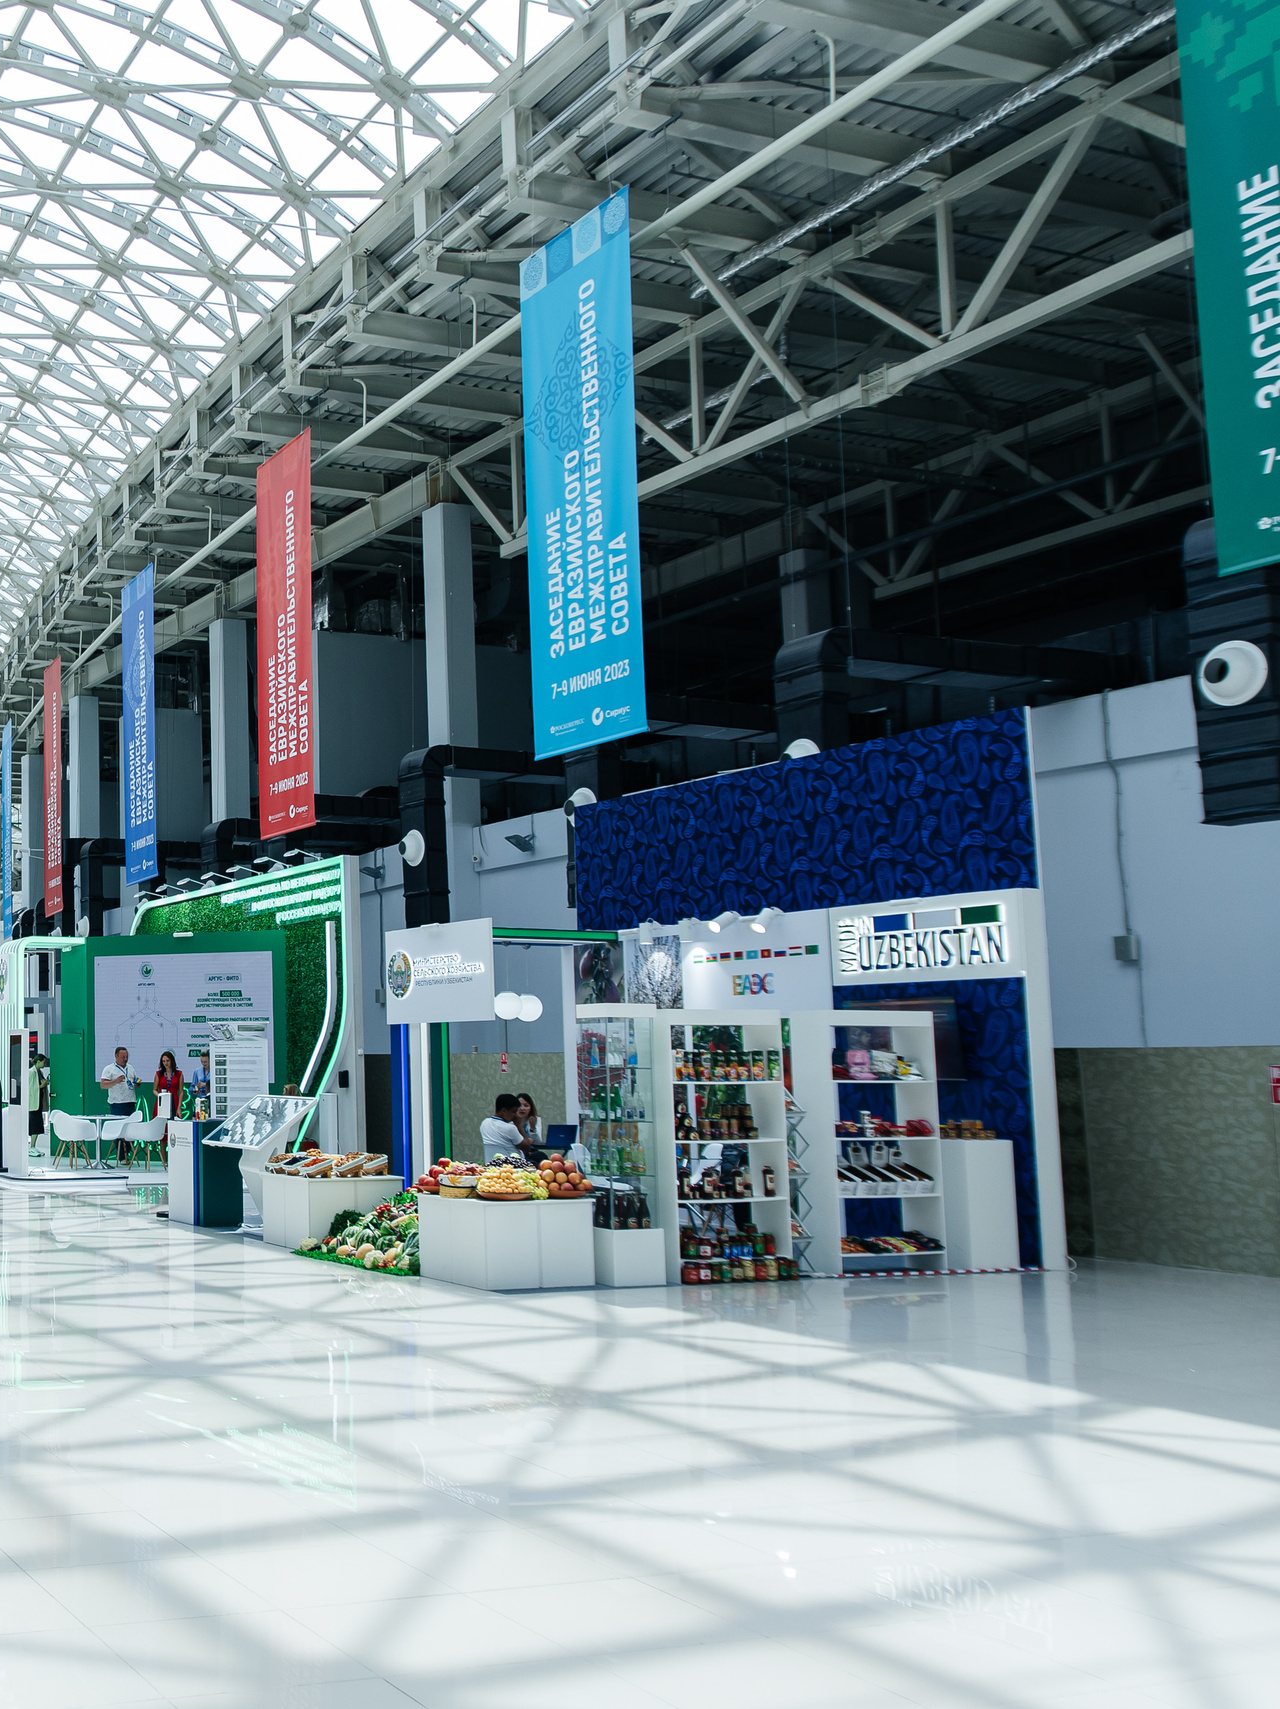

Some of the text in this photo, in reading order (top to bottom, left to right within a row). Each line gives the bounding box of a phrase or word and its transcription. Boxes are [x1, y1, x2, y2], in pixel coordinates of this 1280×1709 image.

[1237, 163, 1280, 410] ЗАСЕДАНИЕ
[578, 278, 607, 644] МЕЖПРАВИТЕЛЬСТВЕННОГО
[546, 507, 565, 659] ЗАСЕДАНИЕ
[563, 449, 586, 651] ЕВРАЗИЙСКОГО
[607, 531, 630, 636] СОВЕТА
[285, 489, 298, 758] МЕЖПРАВИТЕЛЬСТВЕННОГО
[276, 613, 287, 762] ЕВРАЗИЙСКОГО
[569, 667, 602, 694] ИЮНЯ
[604, 658, 630, 683] 2023
[138, 610, 148, 823] МЕЖПРАВИТЕЛЬСТВЕННОГО
[268, 654, 277, 767] ЗАСЕДАНИЕ
[298, 678, 309, 755] СОВЕТА
[605, 705, 631, 718] Сириус
[128, 740, 136, 829] ЗАСЕДАНИЕ
[134, 707, 143, 825] ЕВРАЗИЙСКОГО
[278, 776, 295, 793] ИЮНЯ
[295, 771, 309, 788] 2023
[276, 900, 342, 925] (РОССЕЛЬХОЗНАДЗОР)
[313, 884, 341, 900] НАДЗОРУ
[858, 916, 871, 934] IN
[412, 954, 459, 967] МИНИСТЕРСТВО
[413, 962, 483, 978] СЕЛЬСКОГО ХОЗЯЙСТВА
[838, 918, 858, 974] MADE
[859, 924, 1008, 972] UZBEKISTAN
[415, 976, 473, 987] РЕСПУБЛИКИ УЗБЕКИСТАН
[732, 973, 775, 996] ЕАЭС
